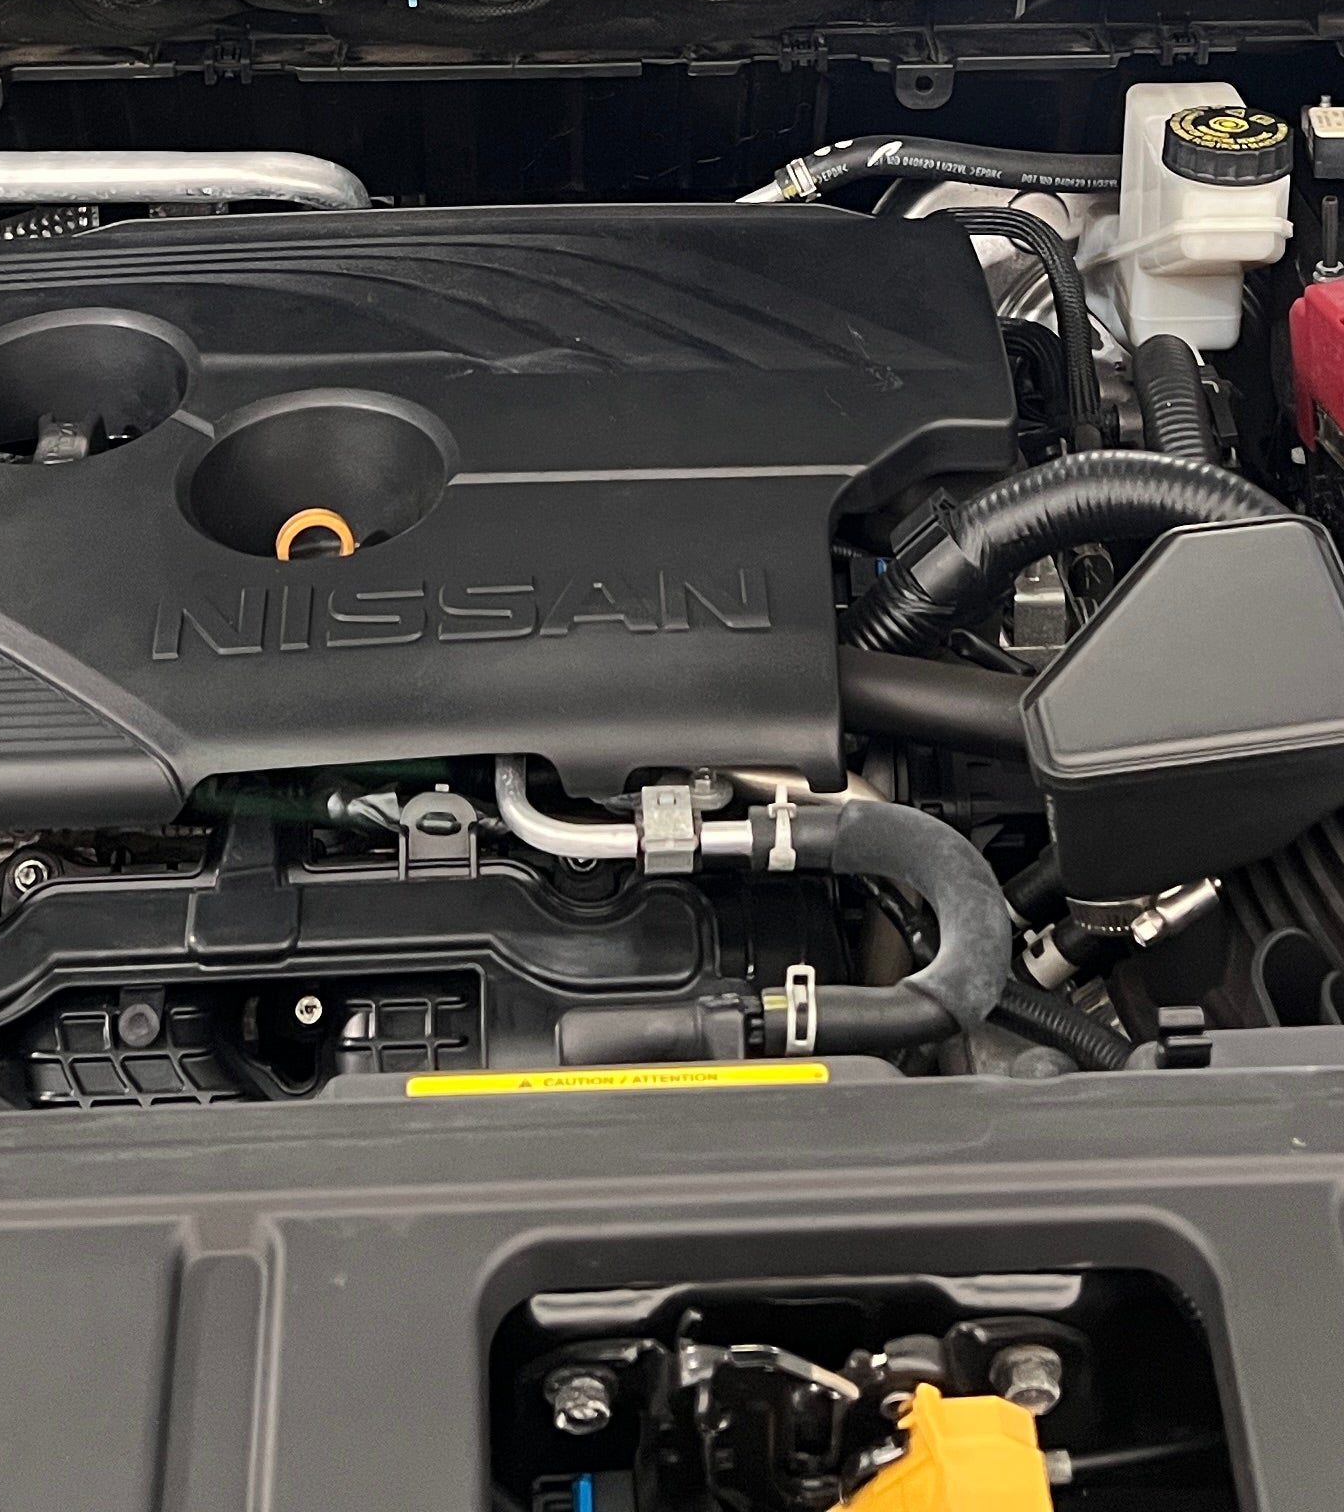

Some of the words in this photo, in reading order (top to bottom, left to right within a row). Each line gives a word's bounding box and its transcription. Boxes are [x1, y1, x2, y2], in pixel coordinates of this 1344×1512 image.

[151, 567, 773, 661] NISSAN
[542, 1076, 615, 1087] CAUTION
[632, 1073, 718, 1085] ATTENTION
